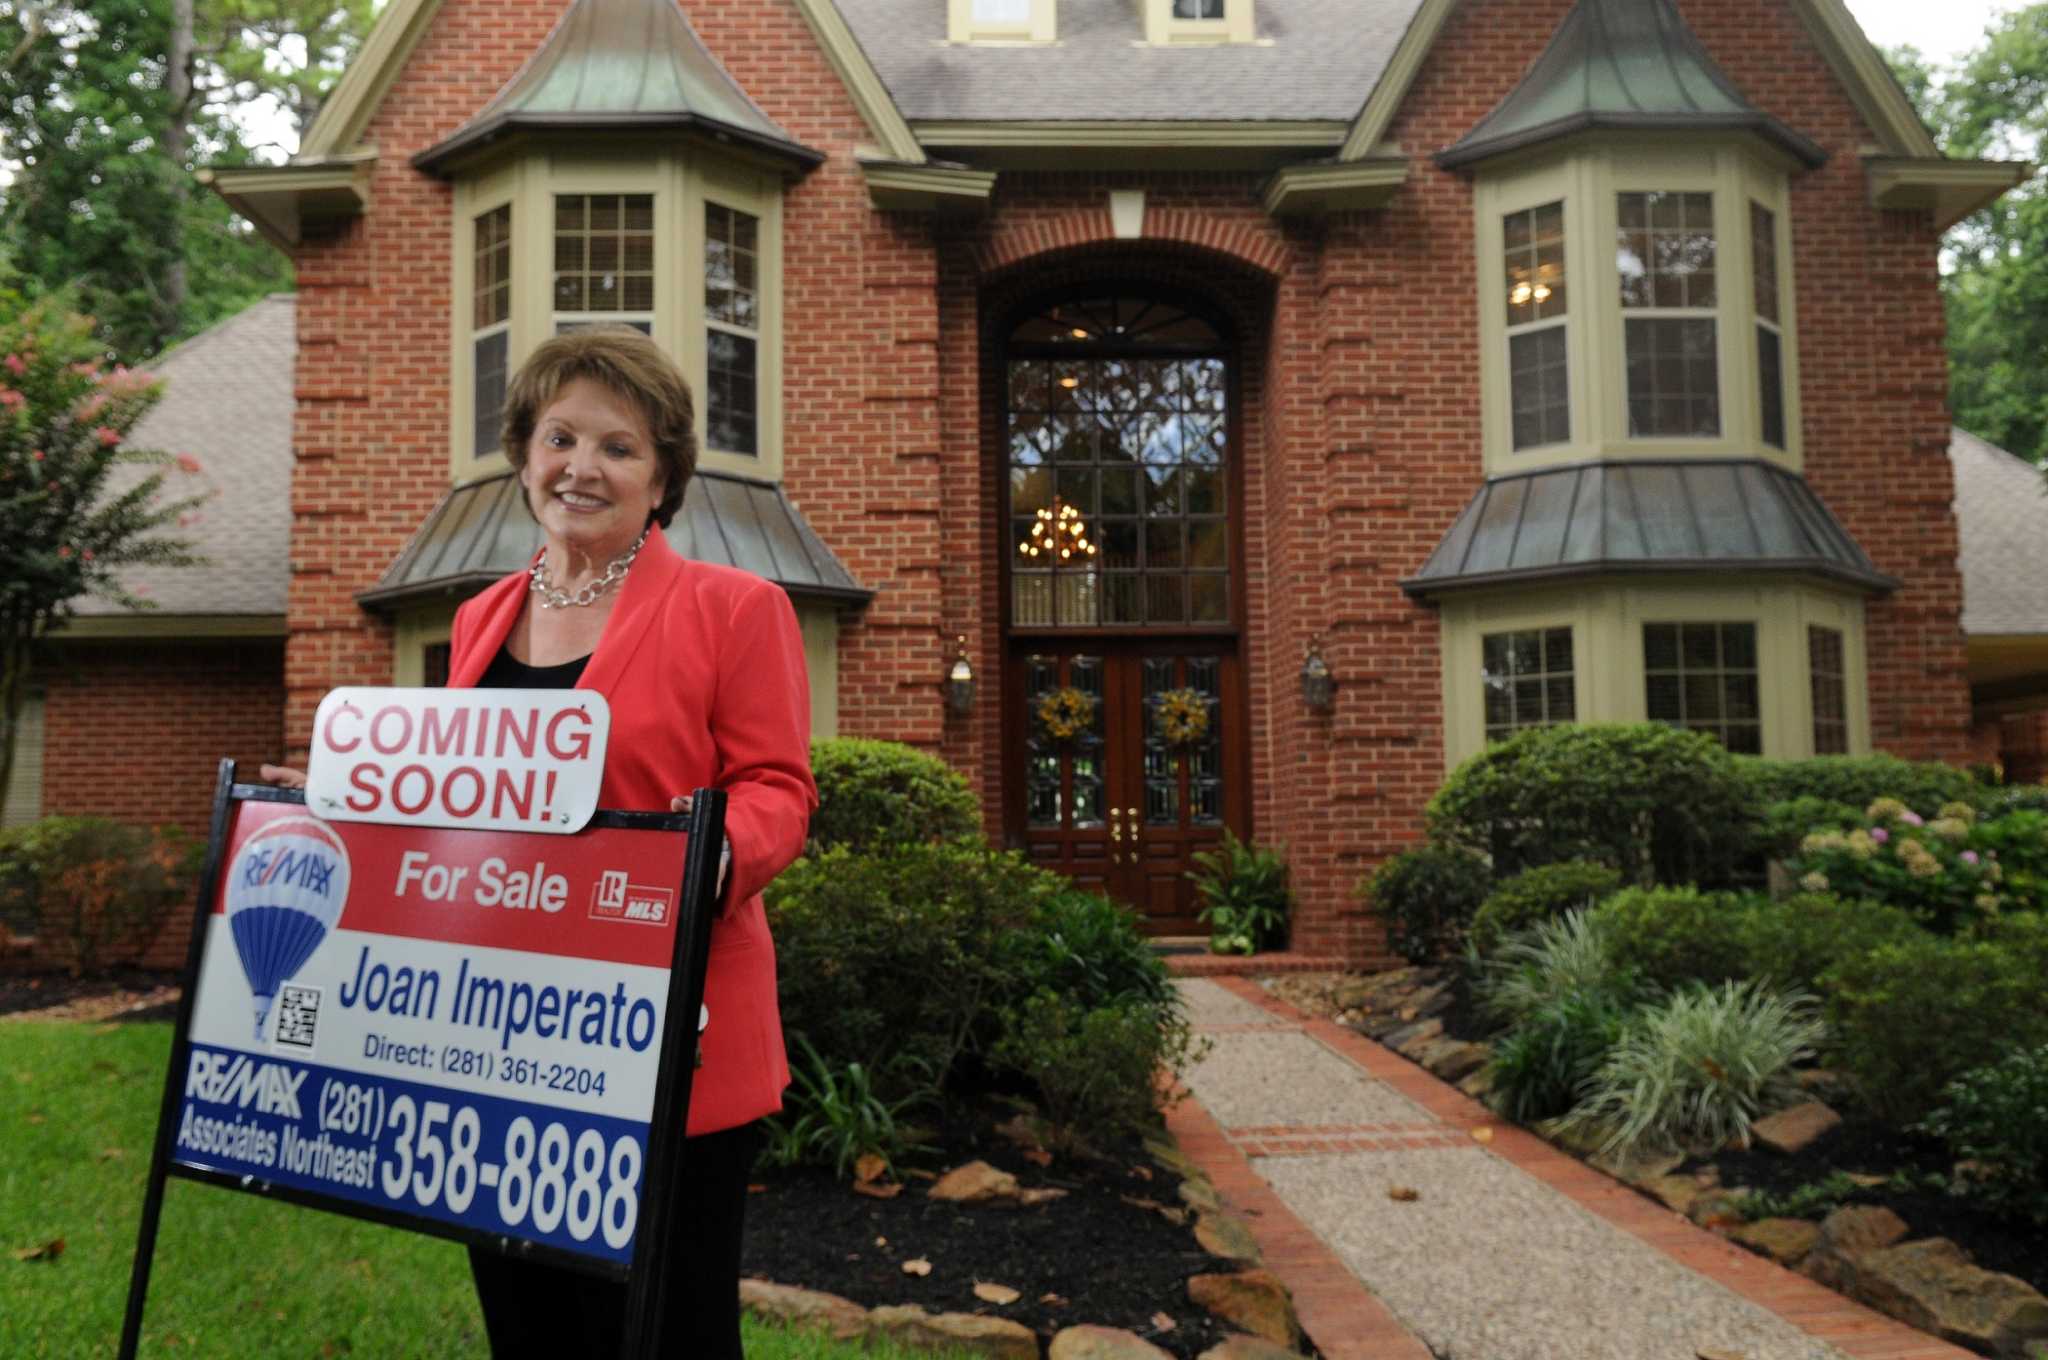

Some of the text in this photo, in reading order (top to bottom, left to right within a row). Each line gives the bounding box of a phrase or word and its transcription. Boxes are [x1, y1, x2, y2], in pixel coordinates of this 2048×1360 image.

[324, 704, 593, 761] COMING
[346, 763, 557, 822] SOON!
[244, 846, 335, 897] RE/MAX
[395, 851, 568, 913] For Sale
[624, 900, 666, 921] MLS
[339, 946, 656, 1052] Joan Imperato
[185, 1050, 309, 1120] RE/MAX
[364, 1034, 606, 1096] Direct: (281) 361-2204
[177, 1103, 377, 1189] Associates Northeast
[382, 1094, 642, 1250] 358-8888
